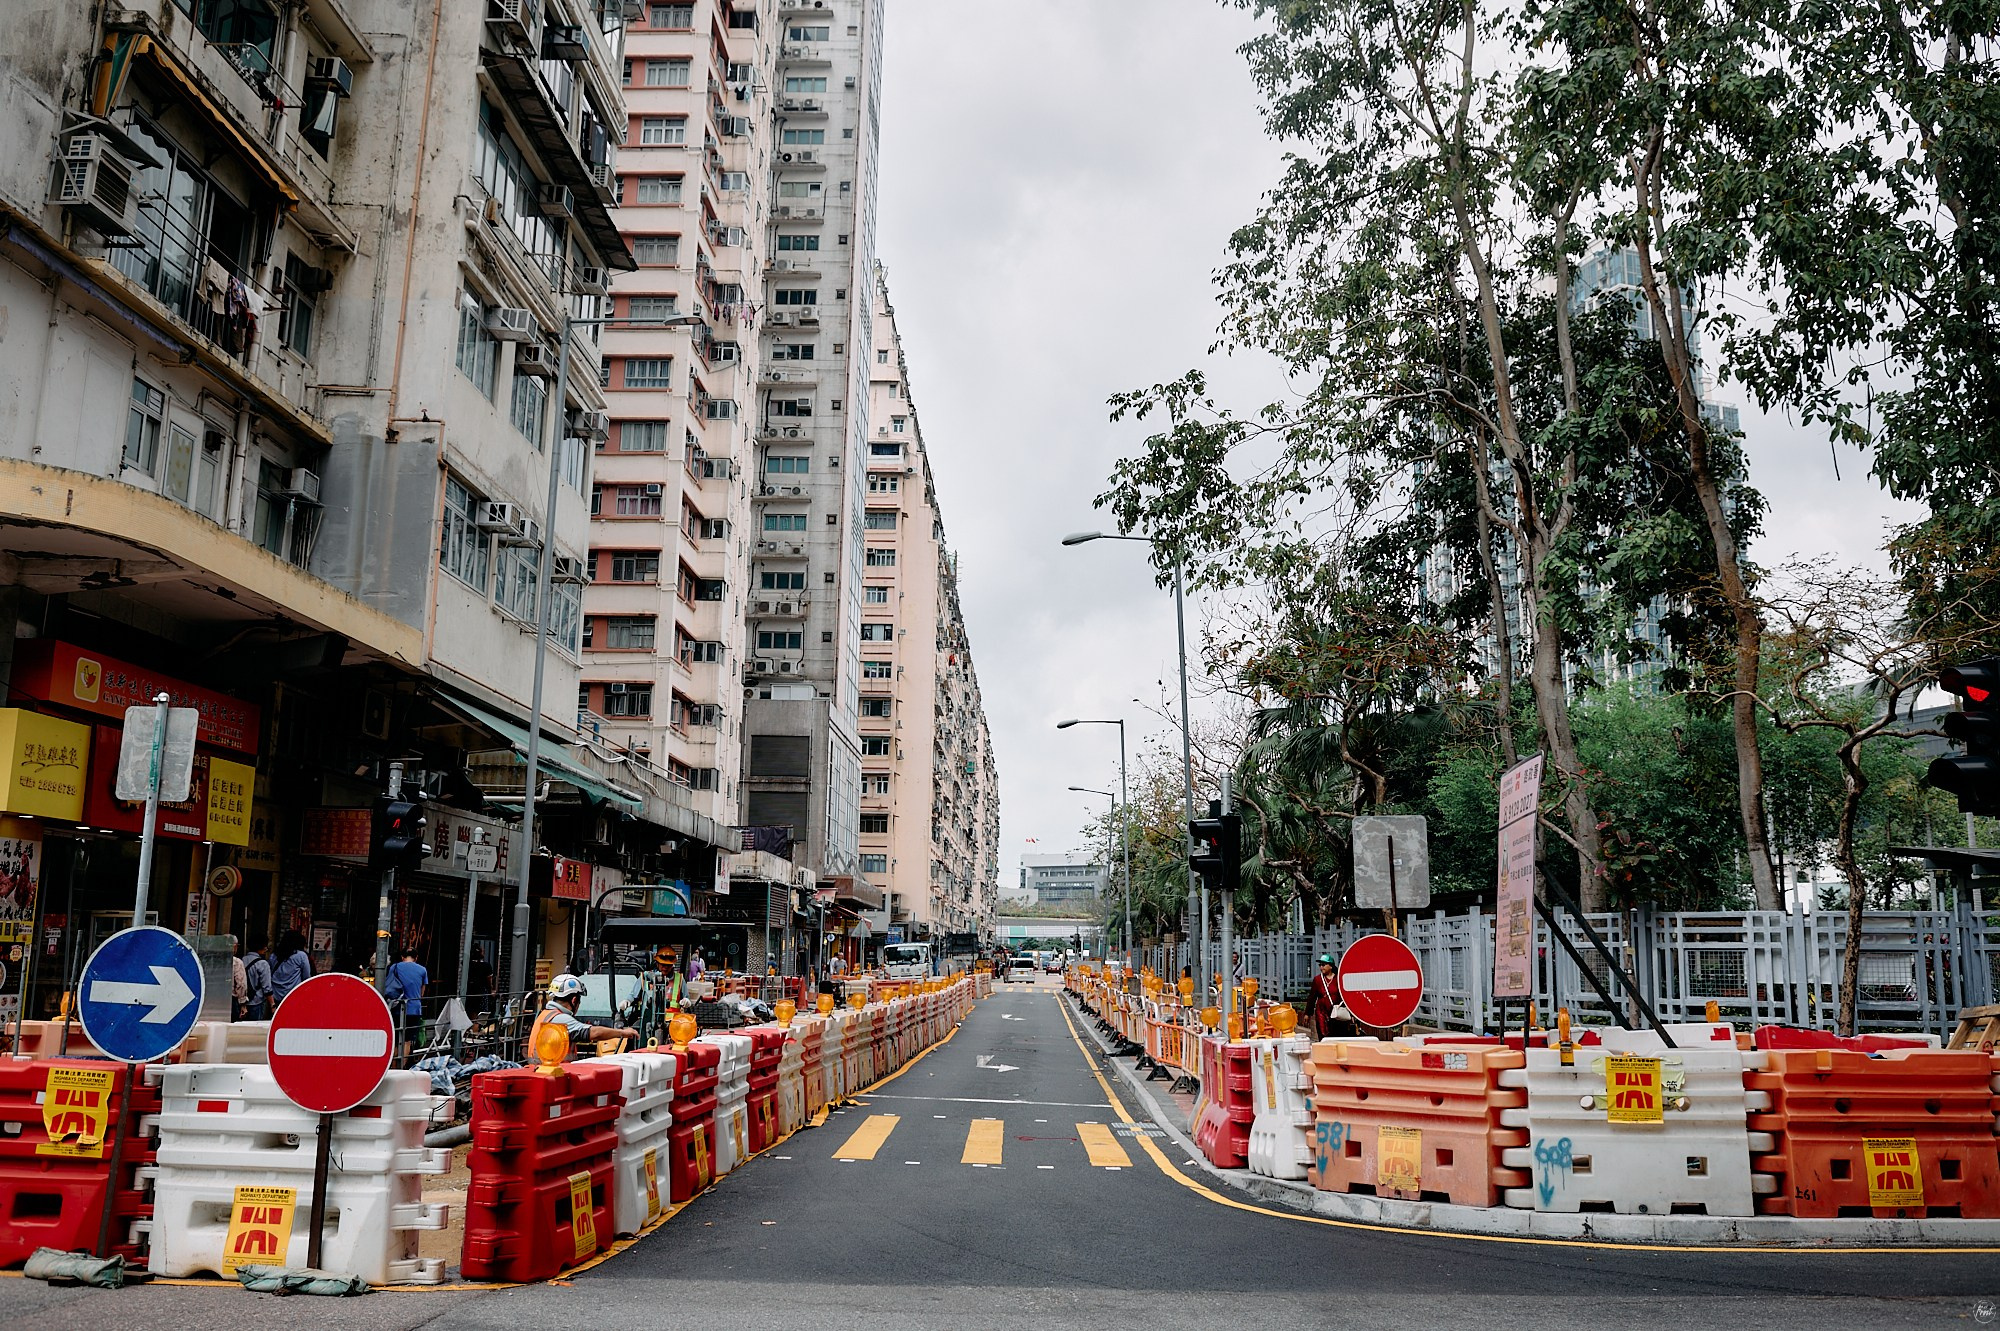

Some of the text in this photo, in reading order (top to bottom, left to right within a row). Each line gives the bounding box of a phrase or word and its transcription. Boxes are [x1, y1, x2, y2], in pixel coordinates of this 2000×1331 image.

[1508, 792, 1533, 820] 9129 2027
[710, 910, 749, 918] ESIGN
[1317, 1122, 1350, 1150] 581
[1534, 1137, 1572, 1168] 608
